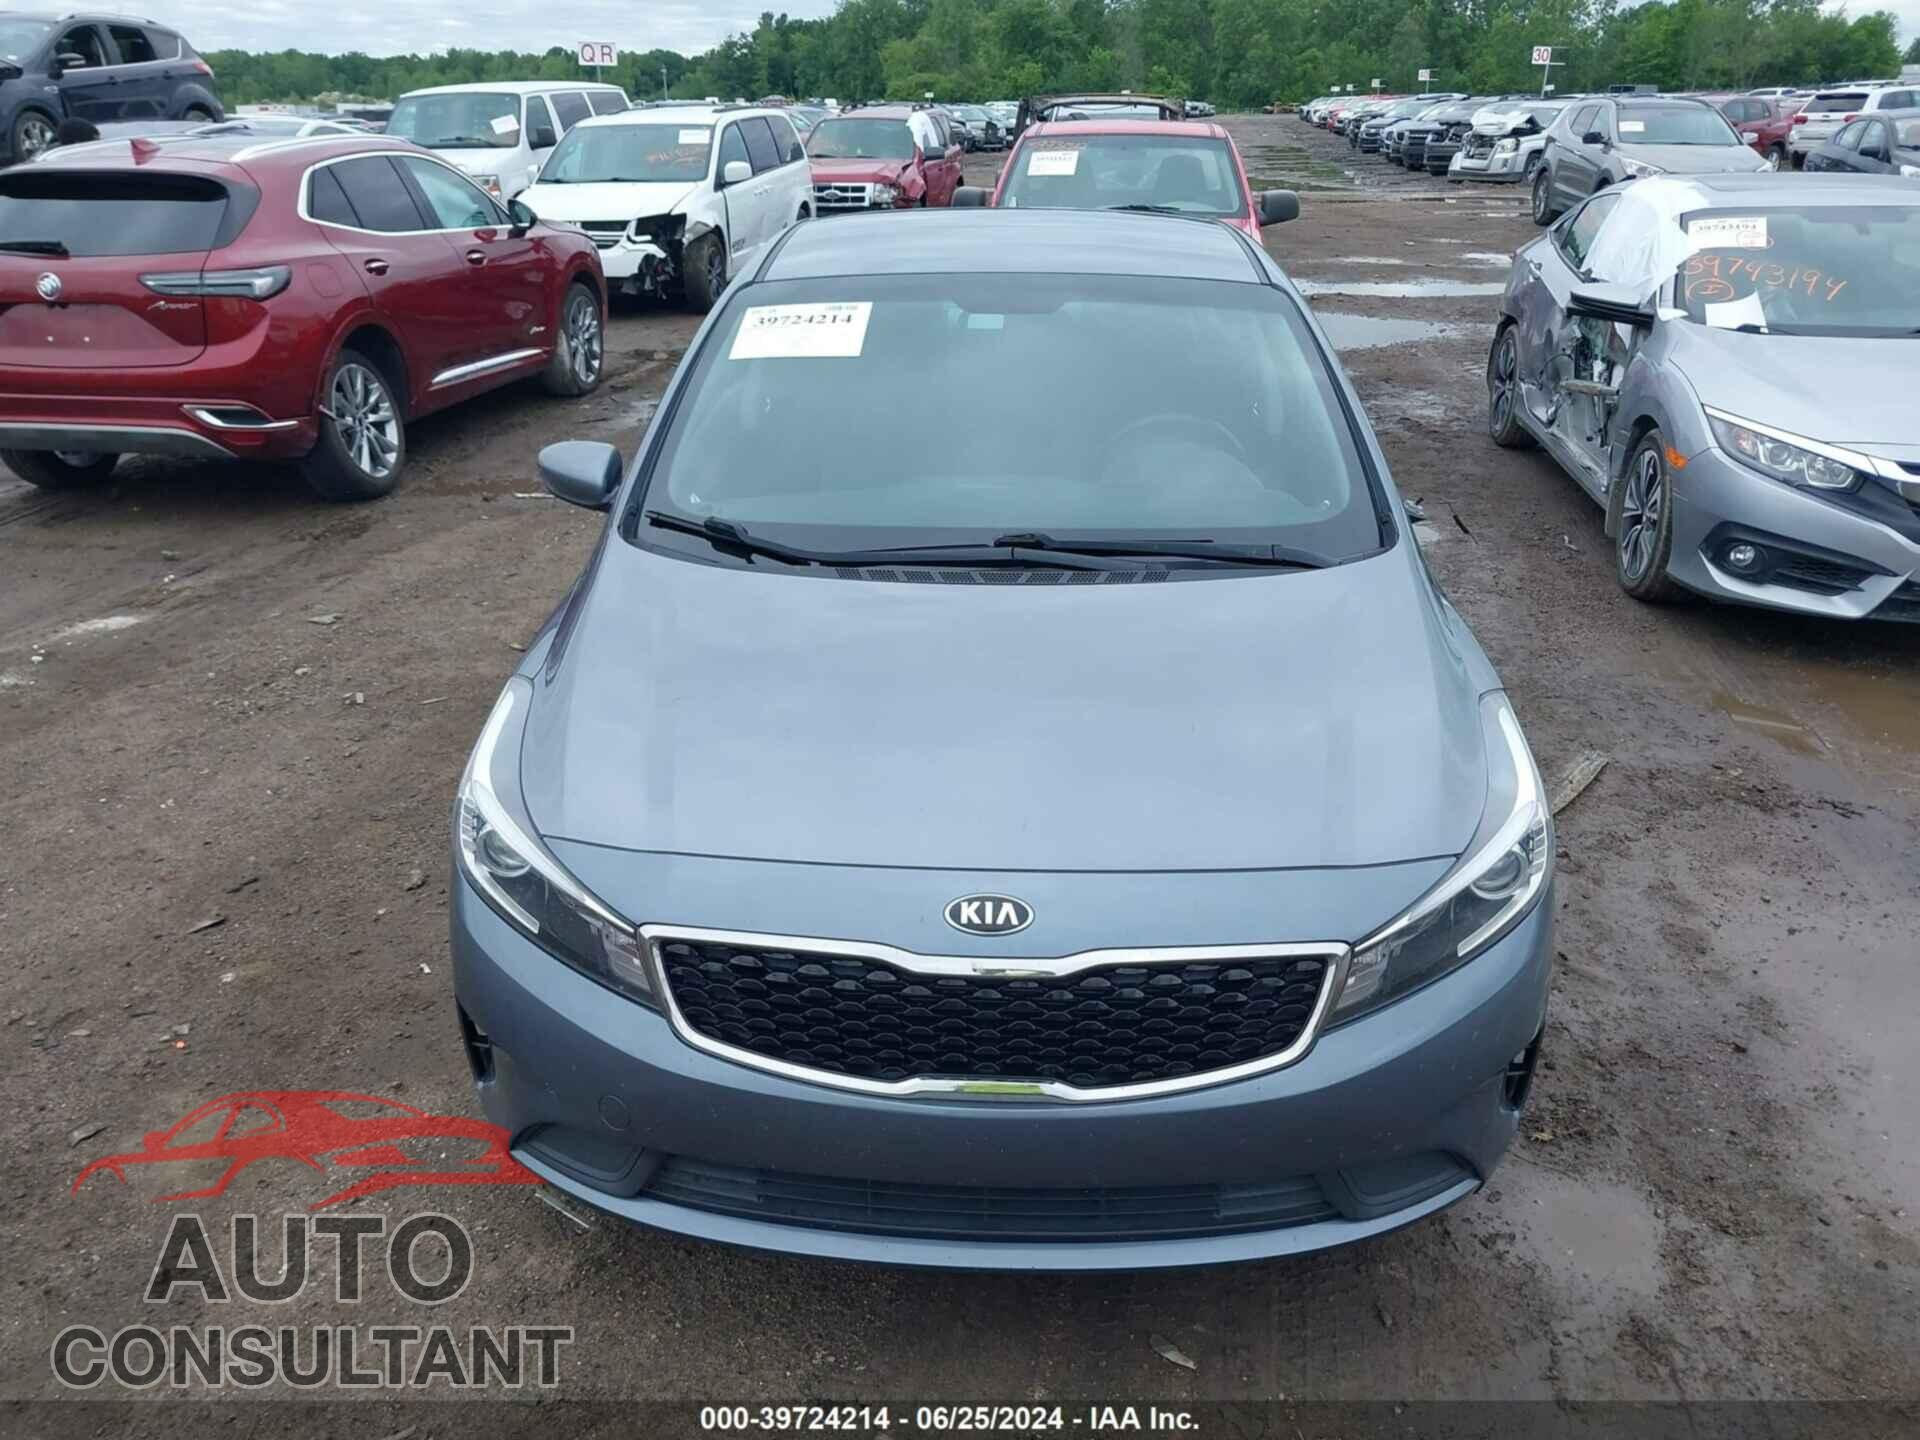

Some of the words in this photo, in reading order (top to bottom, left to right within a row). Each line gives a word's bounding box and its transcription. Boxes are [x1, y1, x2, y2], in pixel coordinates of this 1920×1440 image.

[1534, 48, 1549, 62] 30
[1684, 255, 1848, 301] 39743194
[756, 313, 853, 326] 39724214
[960, 901, 1019, 925] KIA
